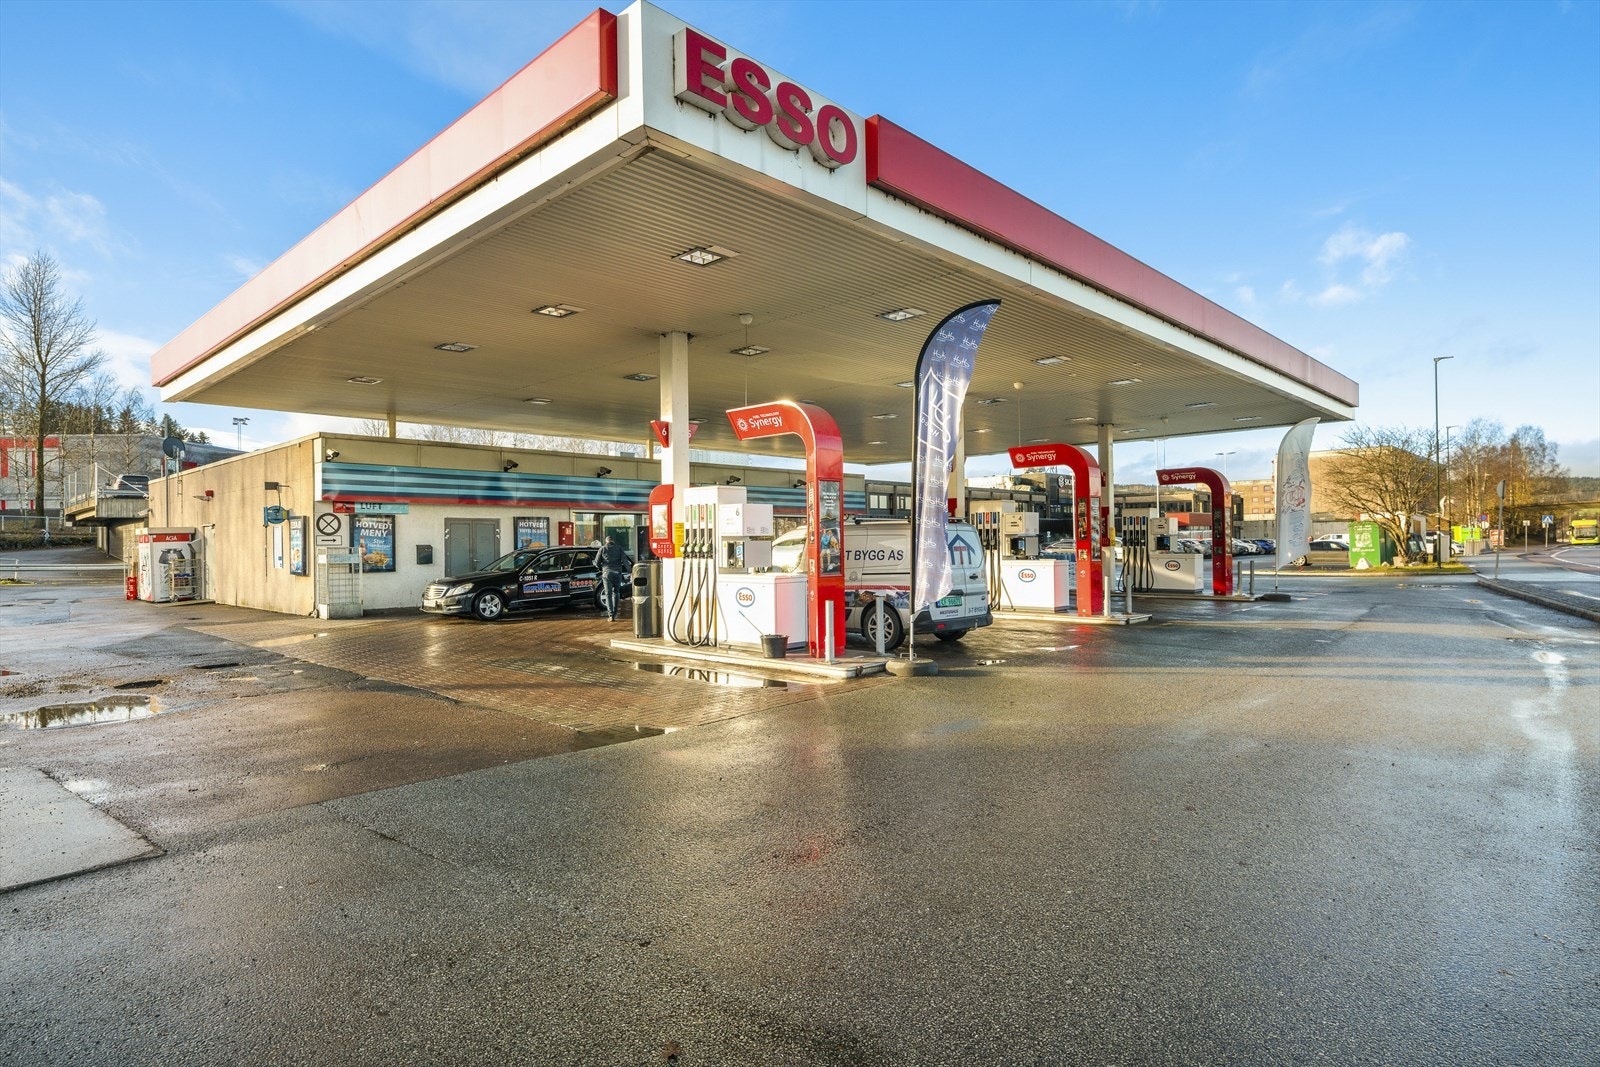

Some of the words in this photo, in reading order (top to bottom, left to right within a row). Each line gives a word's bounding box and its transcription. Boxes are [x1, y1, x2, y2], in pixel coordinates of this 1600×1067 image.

[685, 27, 858, 165] ESSO
[748, 416, 783, 430] Synergy
[662, 428, 667, 436] 6
[1026, 454, 1056, 462] Synergy
[736, 508, 740, 516] 6
[356, 521, 392, 530] HOTVEDT
[360, 529, 388, 537] MENY
[854, 550, 885, 560] BYGG
[888, 550, 904, 560] AS
[738, 592, 753, 601] Esso
